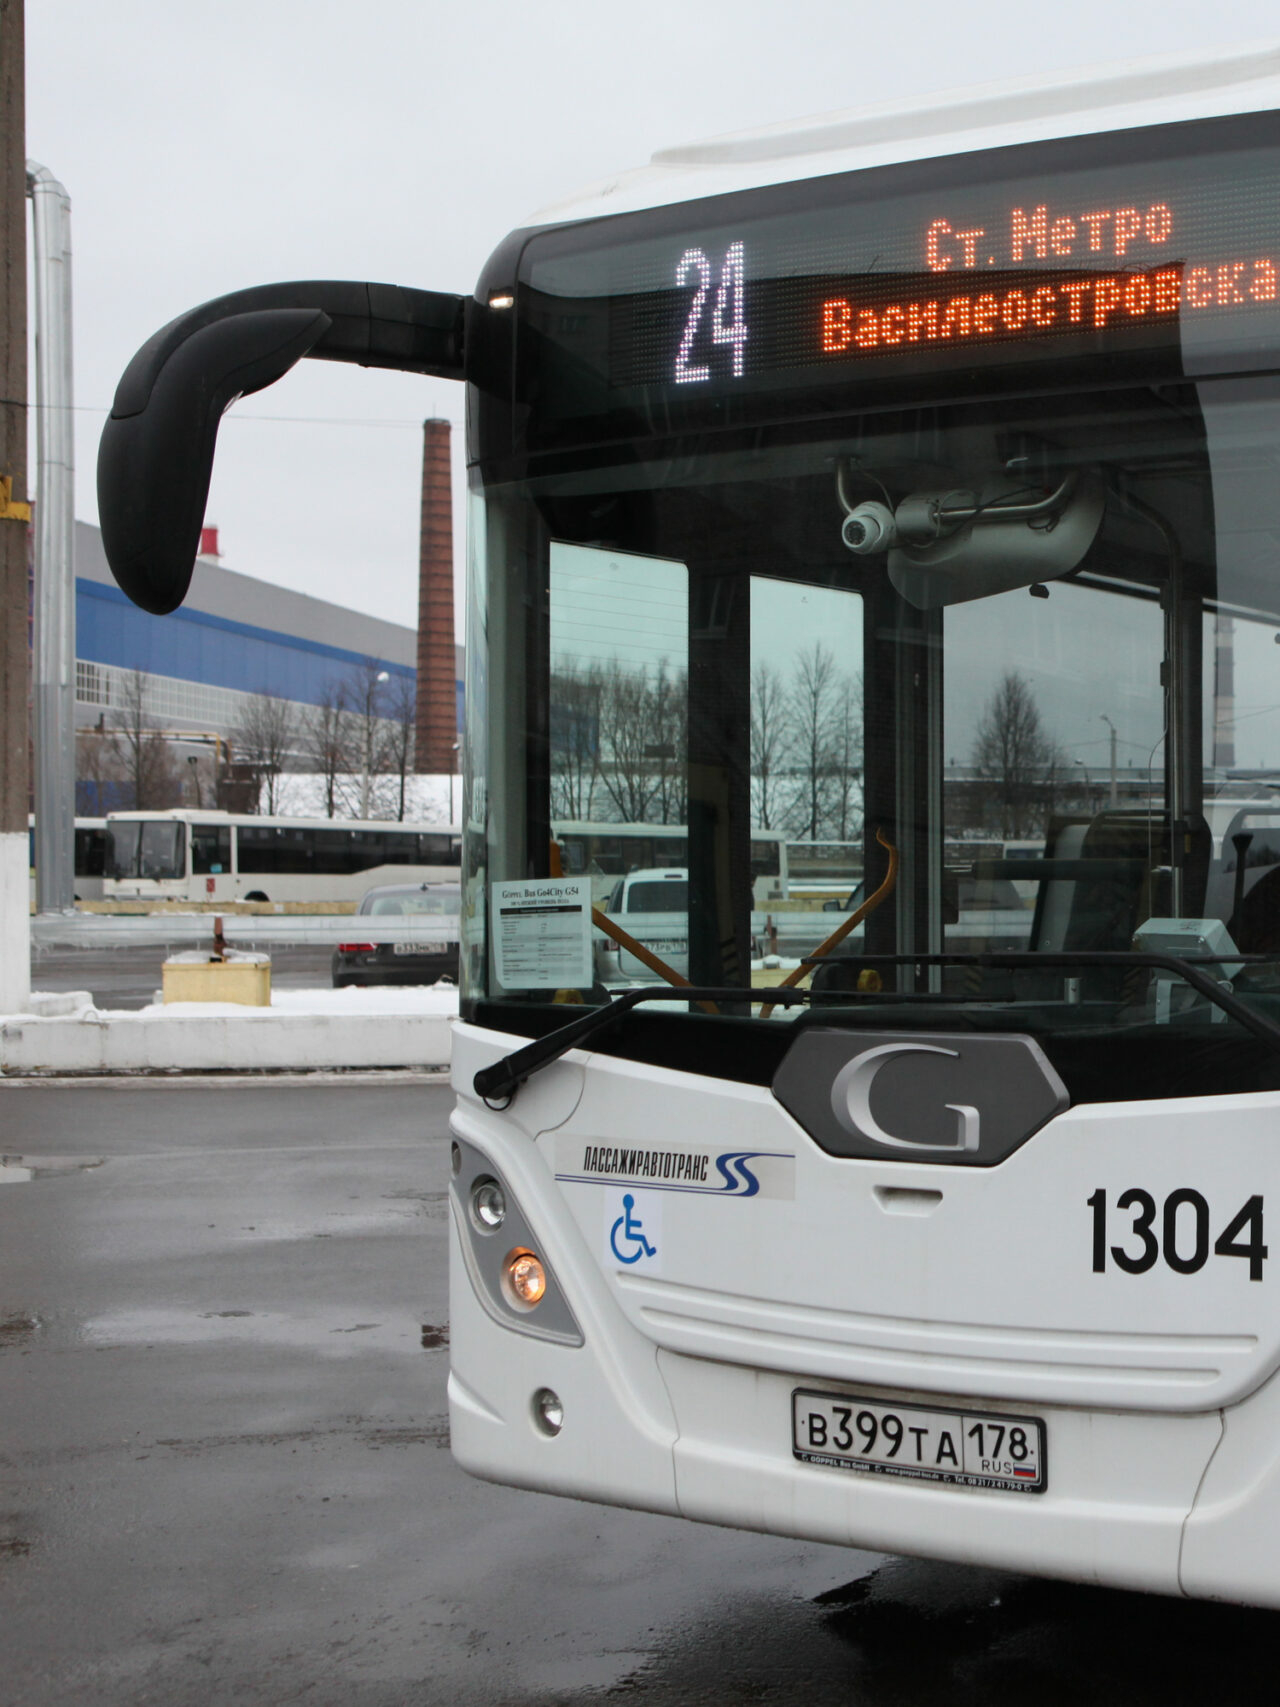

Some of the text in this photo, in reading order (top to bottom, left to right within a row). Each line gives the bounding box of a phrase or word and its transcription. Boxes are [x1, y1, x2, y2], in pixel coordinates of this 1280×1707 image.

[926, 203, 1172, 272] Ст. Метро
[675, 240, 748, 384] 24
[831, 1042, 980, 1152] G
[583, 1145, 709, 1182] ПАССАЖИРАВТОТРАНС
[1087, 1187, 1268, 1282] 1304
[808, 1406, 1028, 1467] В399ТА 178
[852, 1462, 870, 1470] GmbH
[981, 1459, 1012, 1474] RUS
